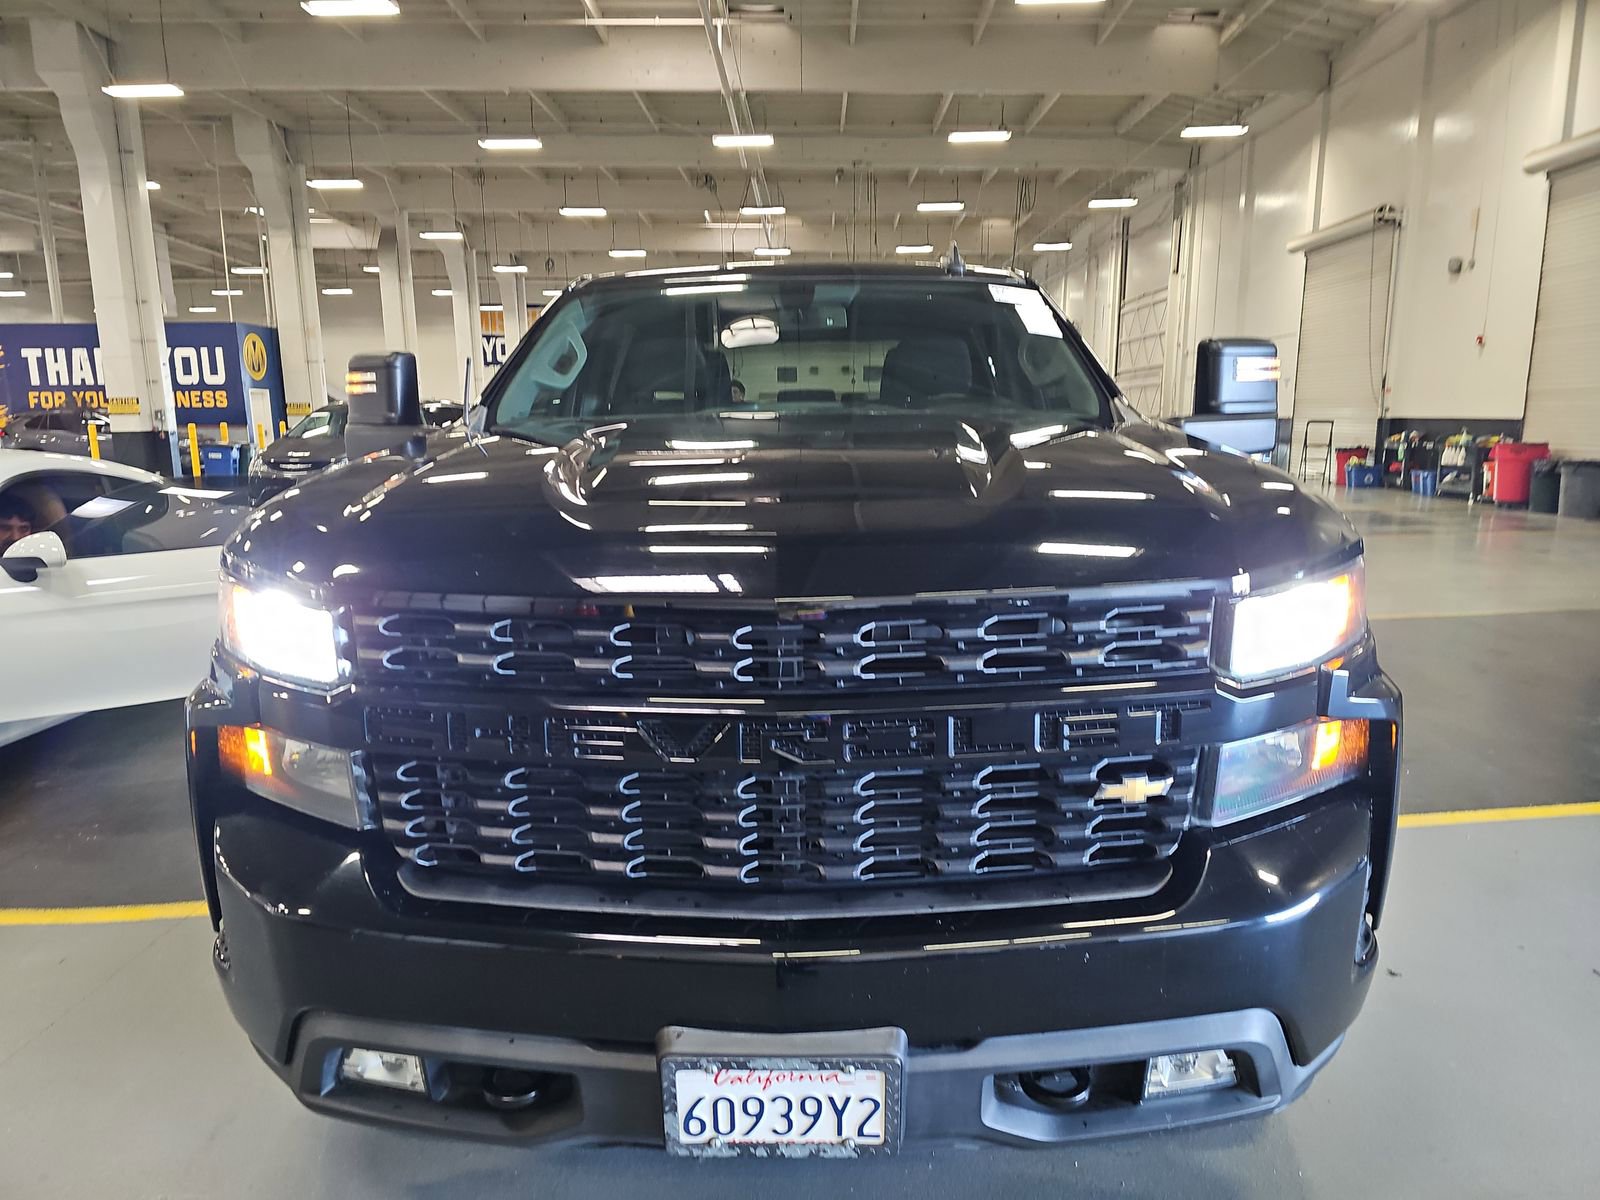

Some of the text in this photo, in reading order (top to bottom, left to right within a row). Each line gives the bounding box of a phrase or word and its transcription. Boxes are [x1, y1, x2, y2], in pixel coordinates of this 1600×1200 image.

[166, 346, 226, 386] OU
[482, 336, 506, 363] YO
[363, 702, 1211, 764] CHEVROLET
[713, 1068, 840, 1091] California
[682, 1095, 881, 1138] 60939Y2
